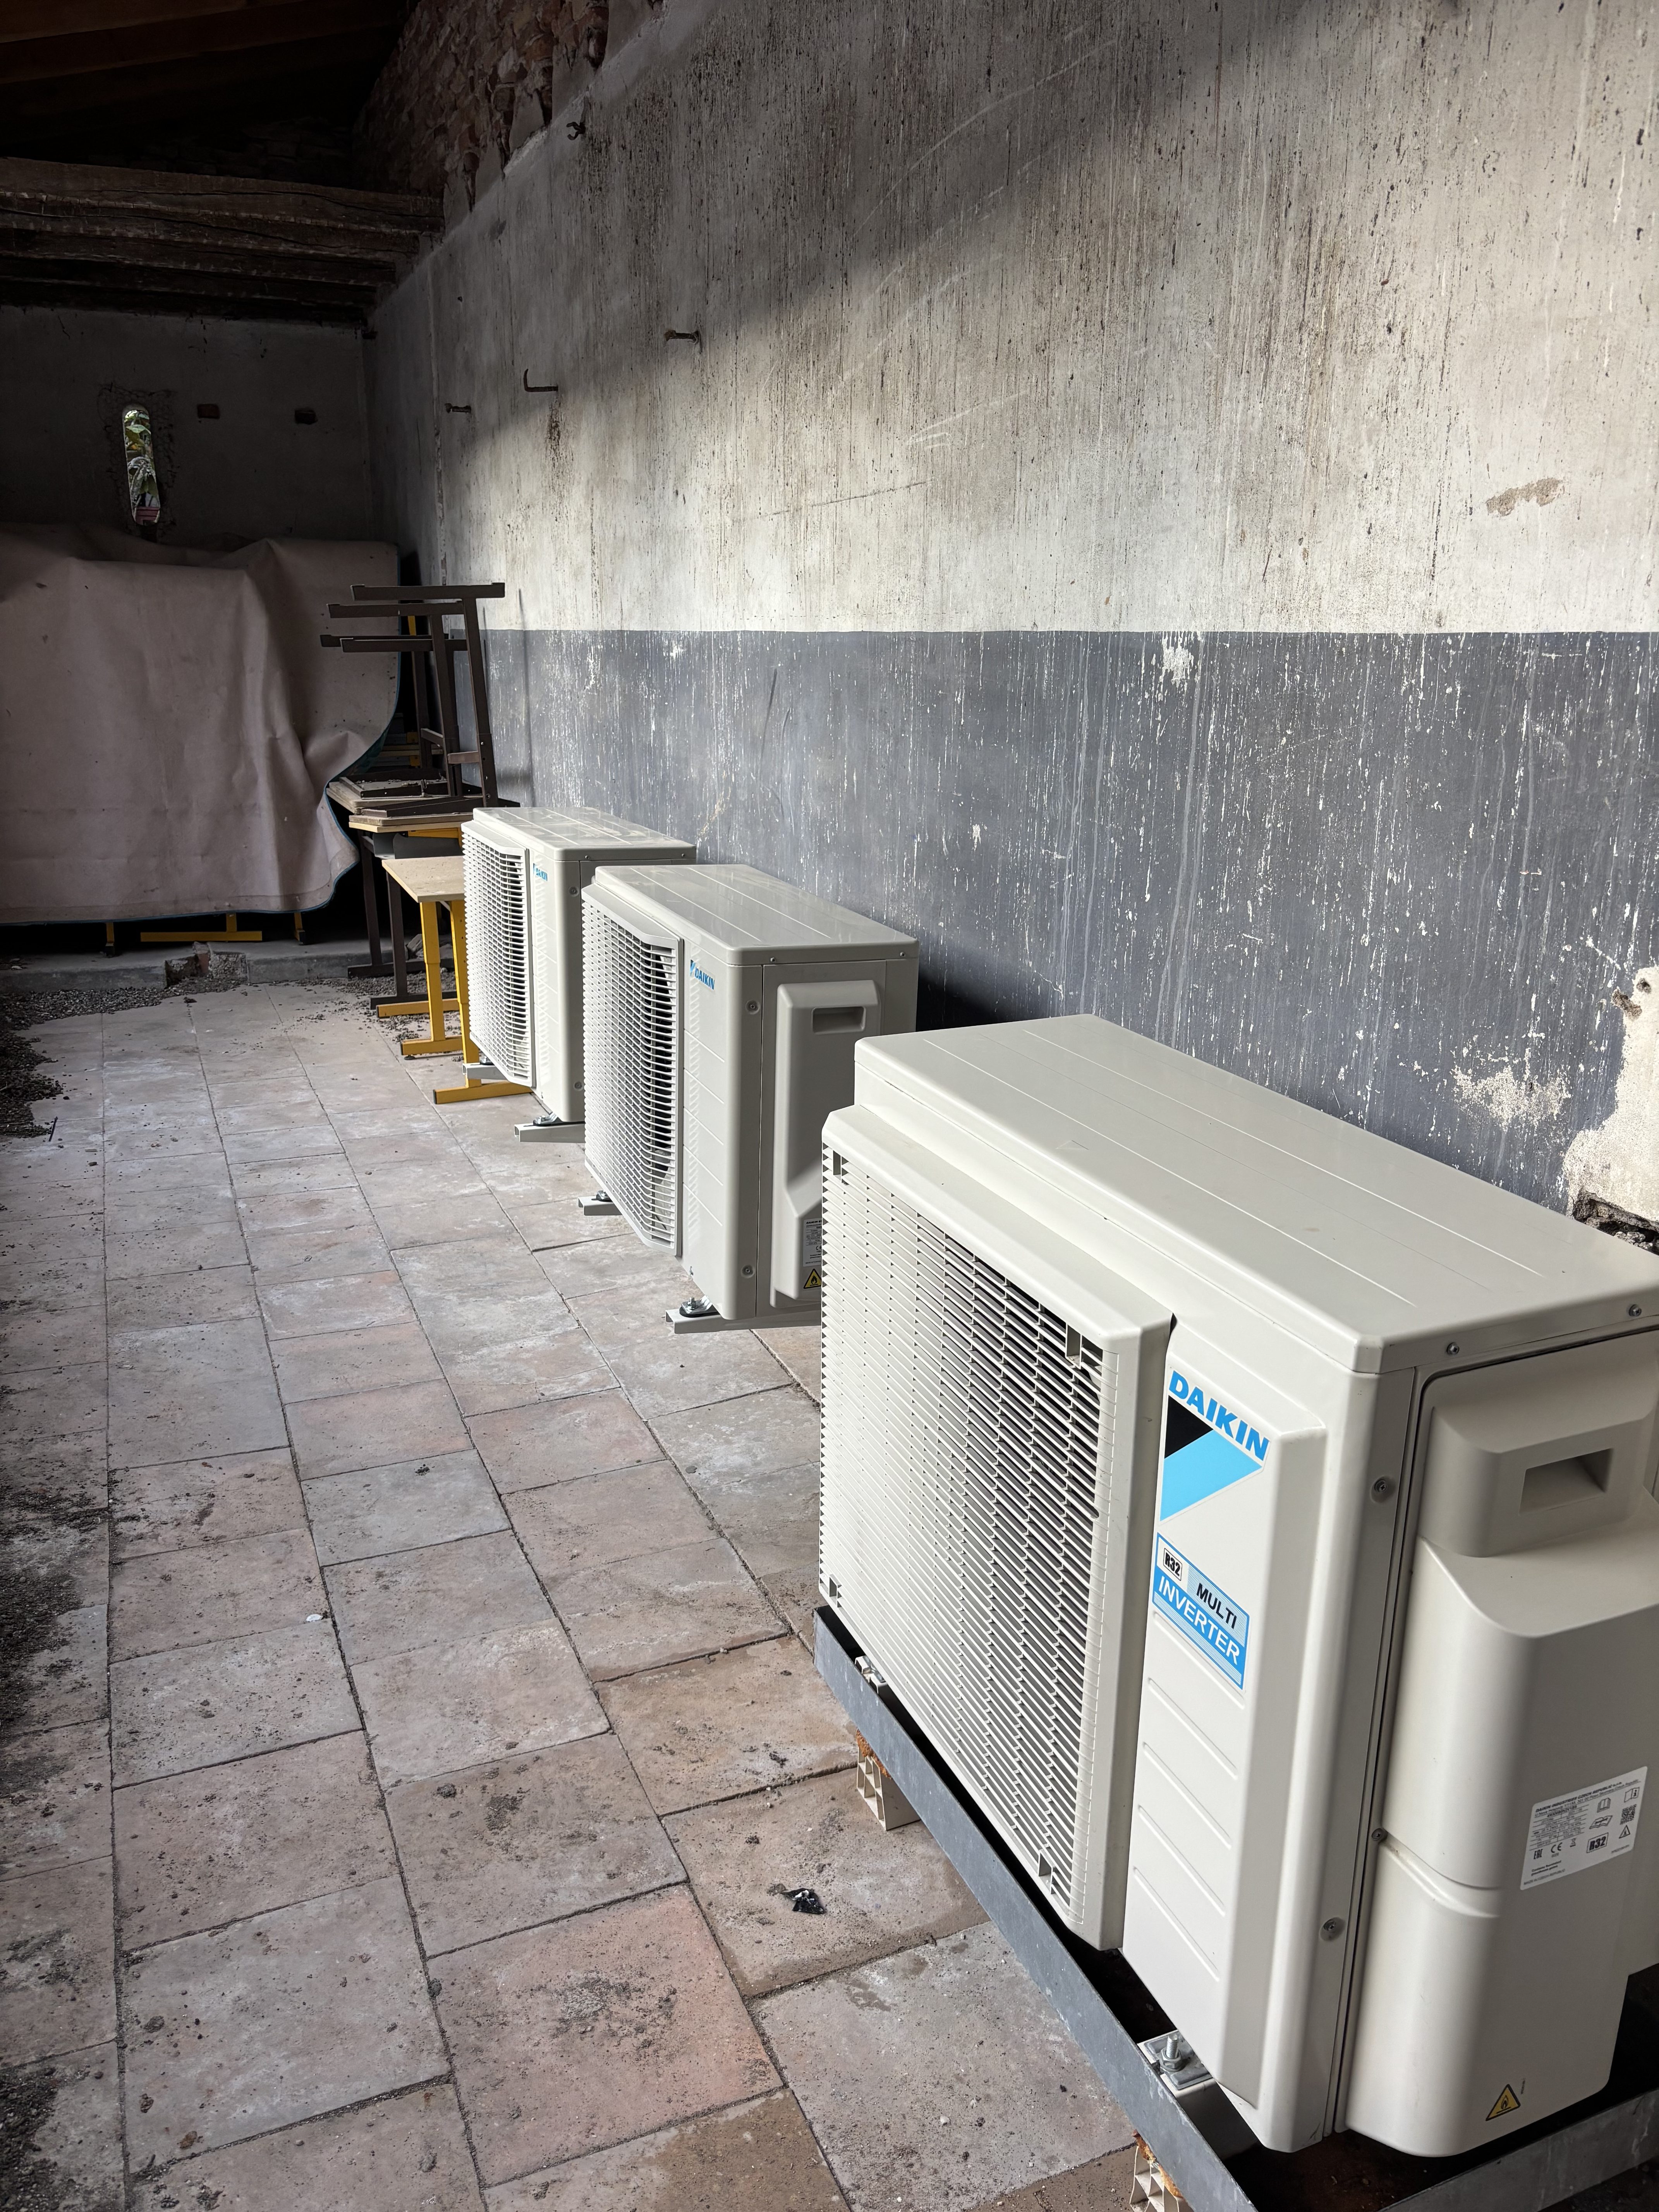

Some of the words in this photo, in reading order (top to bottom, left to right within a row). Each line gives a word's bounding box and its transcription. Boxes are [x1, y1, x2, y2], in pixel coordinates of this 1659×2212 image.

[695, 967, 715, 990] DAIKIN
[1169, 1370, 1269, 1461] DAIKIN
[1165, 1552, 1181, 1577] R32
[1159, 1576, 1240, 1665] INVERTER
[1197, 1583, 1237, 1629] MULTI
[1589, 1836, 1606, 1851] R32
